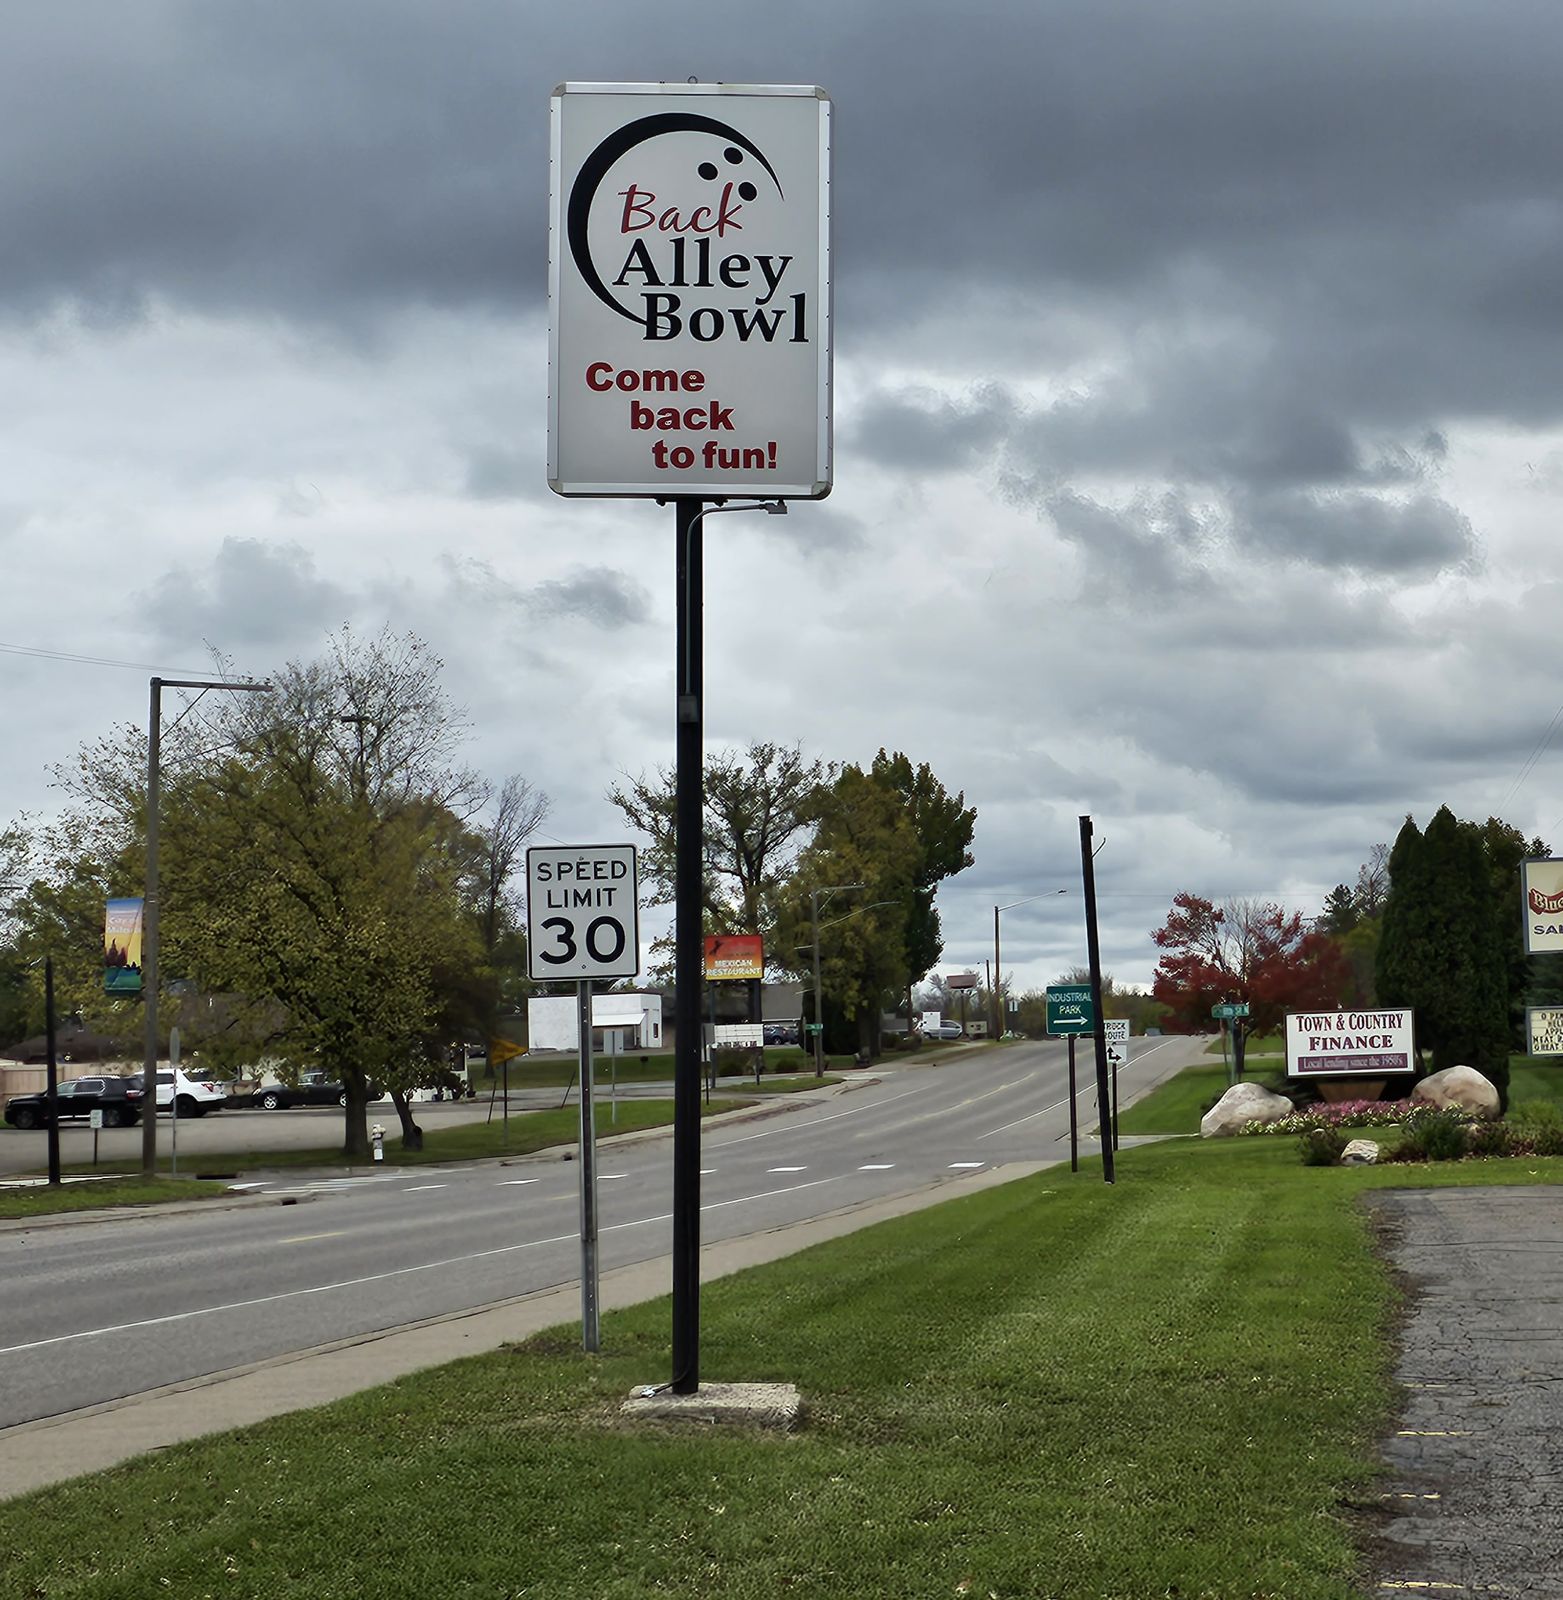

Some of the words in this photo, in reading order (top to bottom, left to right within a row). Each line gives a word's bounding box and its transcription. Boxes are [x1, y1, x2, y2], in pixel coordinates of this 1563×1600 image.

[617, 182, 743, 238] Back
[612, 237, 794, 305] Alley
[640, 292, 809, 343] Bowl
[586, 362, 705, 392] Come
[630, 400, 735, 430] back
[652, 439, 695, 469] to
[702, 441, 777, 469] fun!
[537, 860, 627, 881] SPEED
[547, 887, 617, 909] LIMIT
[539, 915, 626, 965] 30
[1059, 1004, 1082, 1015] PARK
[1296, 1015, 1332, 1032] TOWN
[1336, 1013, 1345, 1031] &
[1348, 1013, 1403, 1030] COUNTRY
[1309, 1035, 1393, 1051] FINANCE
[1303, 1057, 1323, 1069] Local
[1324, 1057, 1349, 1070] lending
[1350, 1058, 1368, 1067] since
[1368, 1056, 1380, 1067] the
